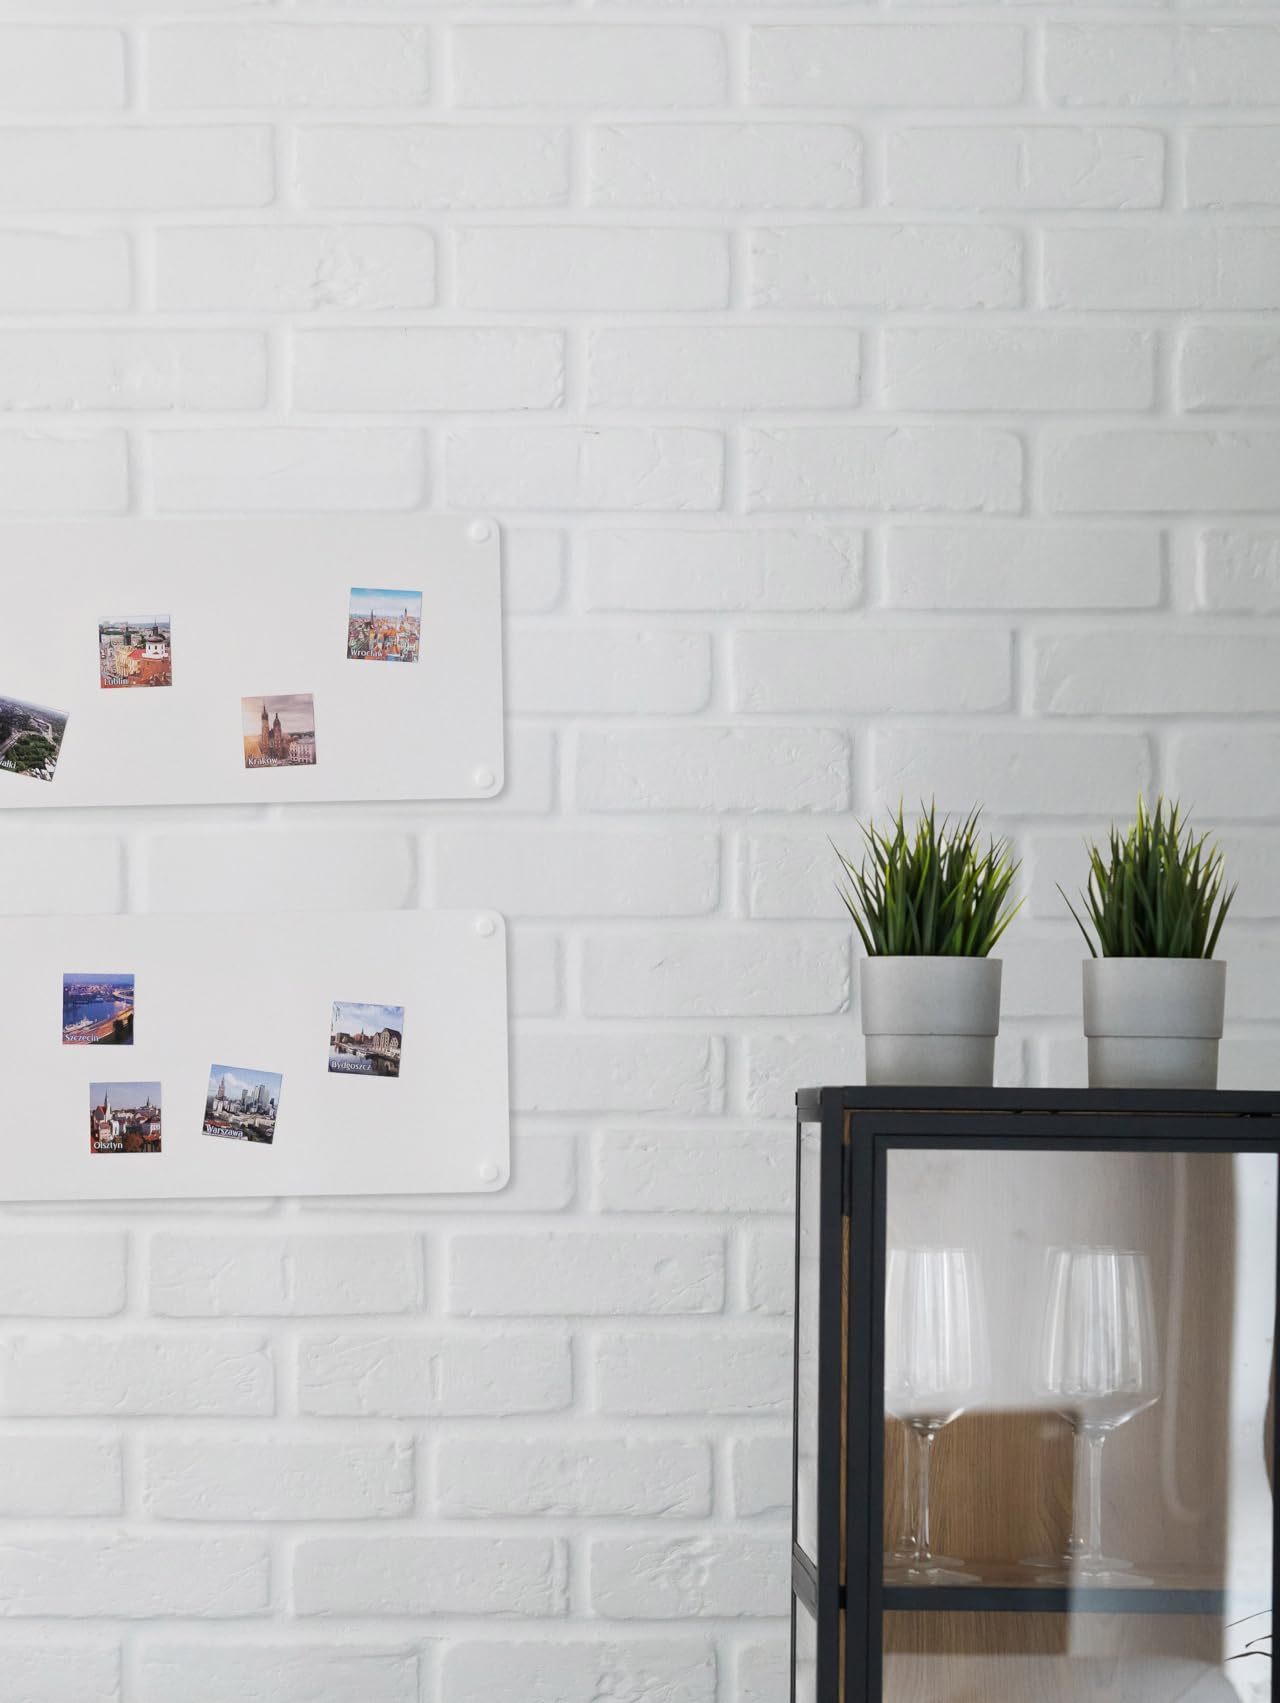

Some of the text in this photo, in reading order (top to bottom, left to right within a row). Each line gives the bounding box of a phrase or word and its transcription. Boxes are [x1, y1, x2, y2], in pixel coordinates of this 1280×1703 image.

[103, 677, 128, 685] Lublin
[65, 1034, 99, 1042] Szczecin
[331, 1060, 371, 1071] Bydgoszcz
[206, 1124, 243, 1137] Warszawa
[93, 1141, 123, 1150] Olsztyn
